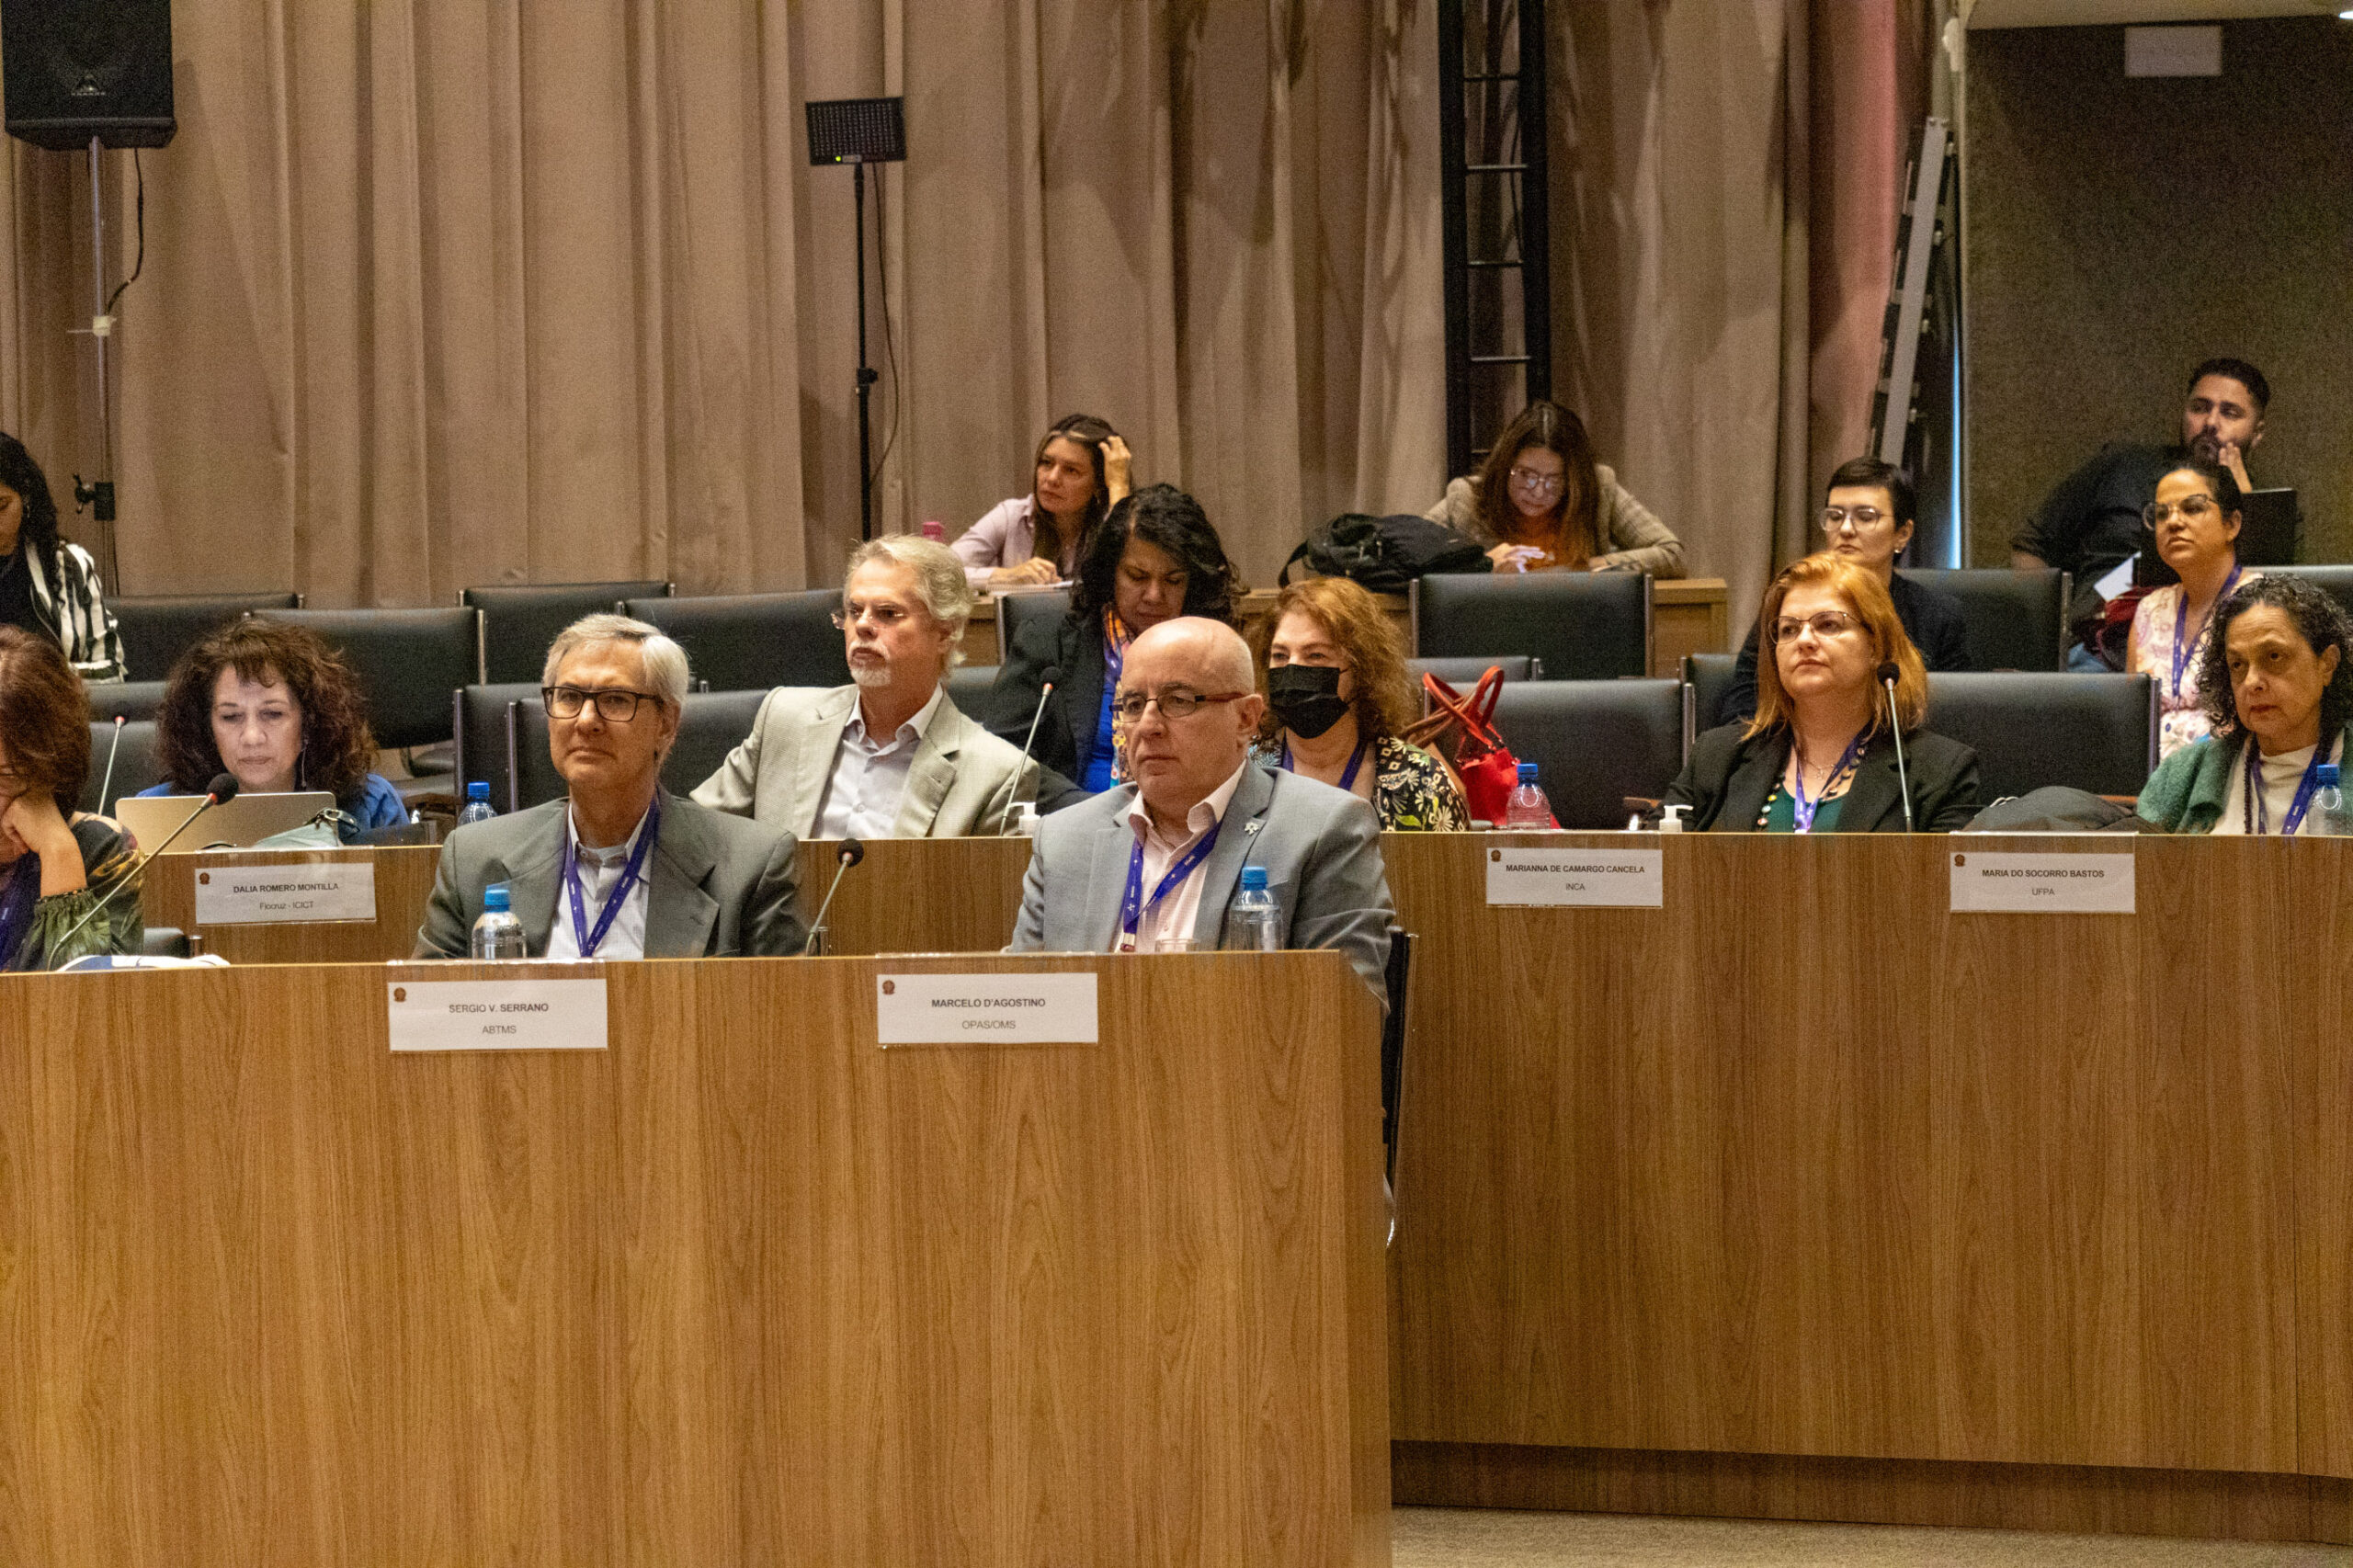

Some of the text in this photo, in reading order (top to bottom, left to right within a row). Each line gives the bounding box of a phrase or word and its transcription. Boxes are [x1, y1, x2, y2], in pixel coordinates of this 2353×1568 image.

[1506, 864, 1549, 872] MARIANNA
[1563, 865, 1605, 873] CAMARGO
[1982, 869, 2105, 878] MARIA DO SOCORRO BASTOS
[233, 883, 339, 893] DALIA ROMERO MONTILLA
[1565, 882, 1586, 891] INCA
[2031, 888, 2055, 896] UFPA
[292, 901, 314, 909] ICICT
[931, 998, 1046, 1008] MARCELO D'AGOSTINO
[449, 1003, 550, 1013] SERGIO V. SERRANO
[961, 1020, 1017, 1029] OPAS/OMS
[482, 1025, 517, 1034] ABTMS
